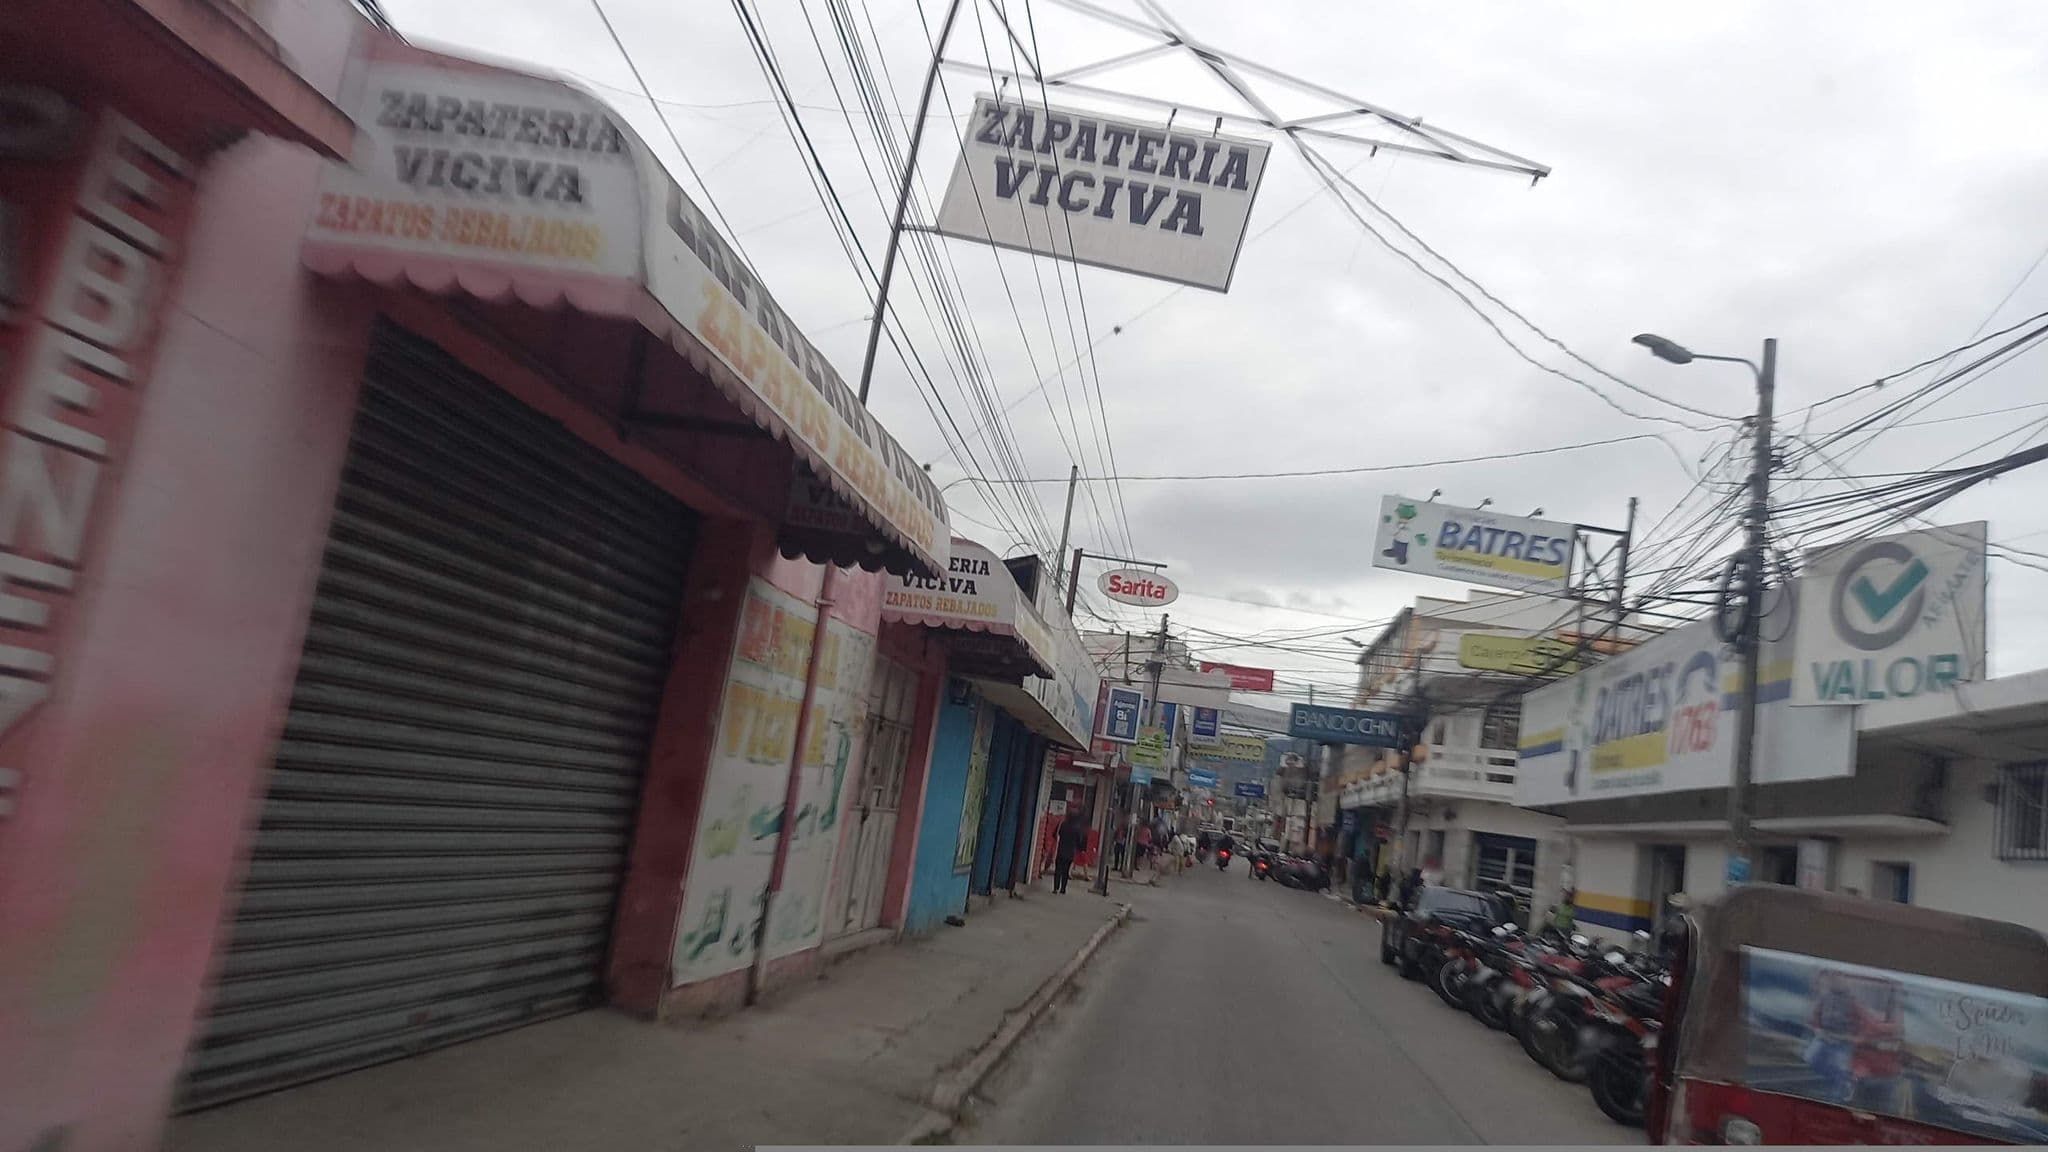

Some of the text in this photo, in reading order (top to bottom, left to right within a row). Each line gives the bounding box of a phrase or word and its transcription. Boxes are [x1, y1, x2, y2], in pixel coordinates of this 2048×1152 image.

[378, 89, 621, 153] ZAPATERIA
[976, 102, 1250, 191] ZAPATERIA
[394, 145, 585, 204] VICIVA
[994, 156, 1204, 237] VICIVA
[316, 193, 434, 240] ZAPATOS
[1434, 520, 1569, 566] BATRES
[886, 592, 932, 610] ZAPATOS
[1108, 574, 1166, 600] Sarita
[1811, 654, 1960, 701] VALOR
[1295, 710, 1358, 732] BANCO
